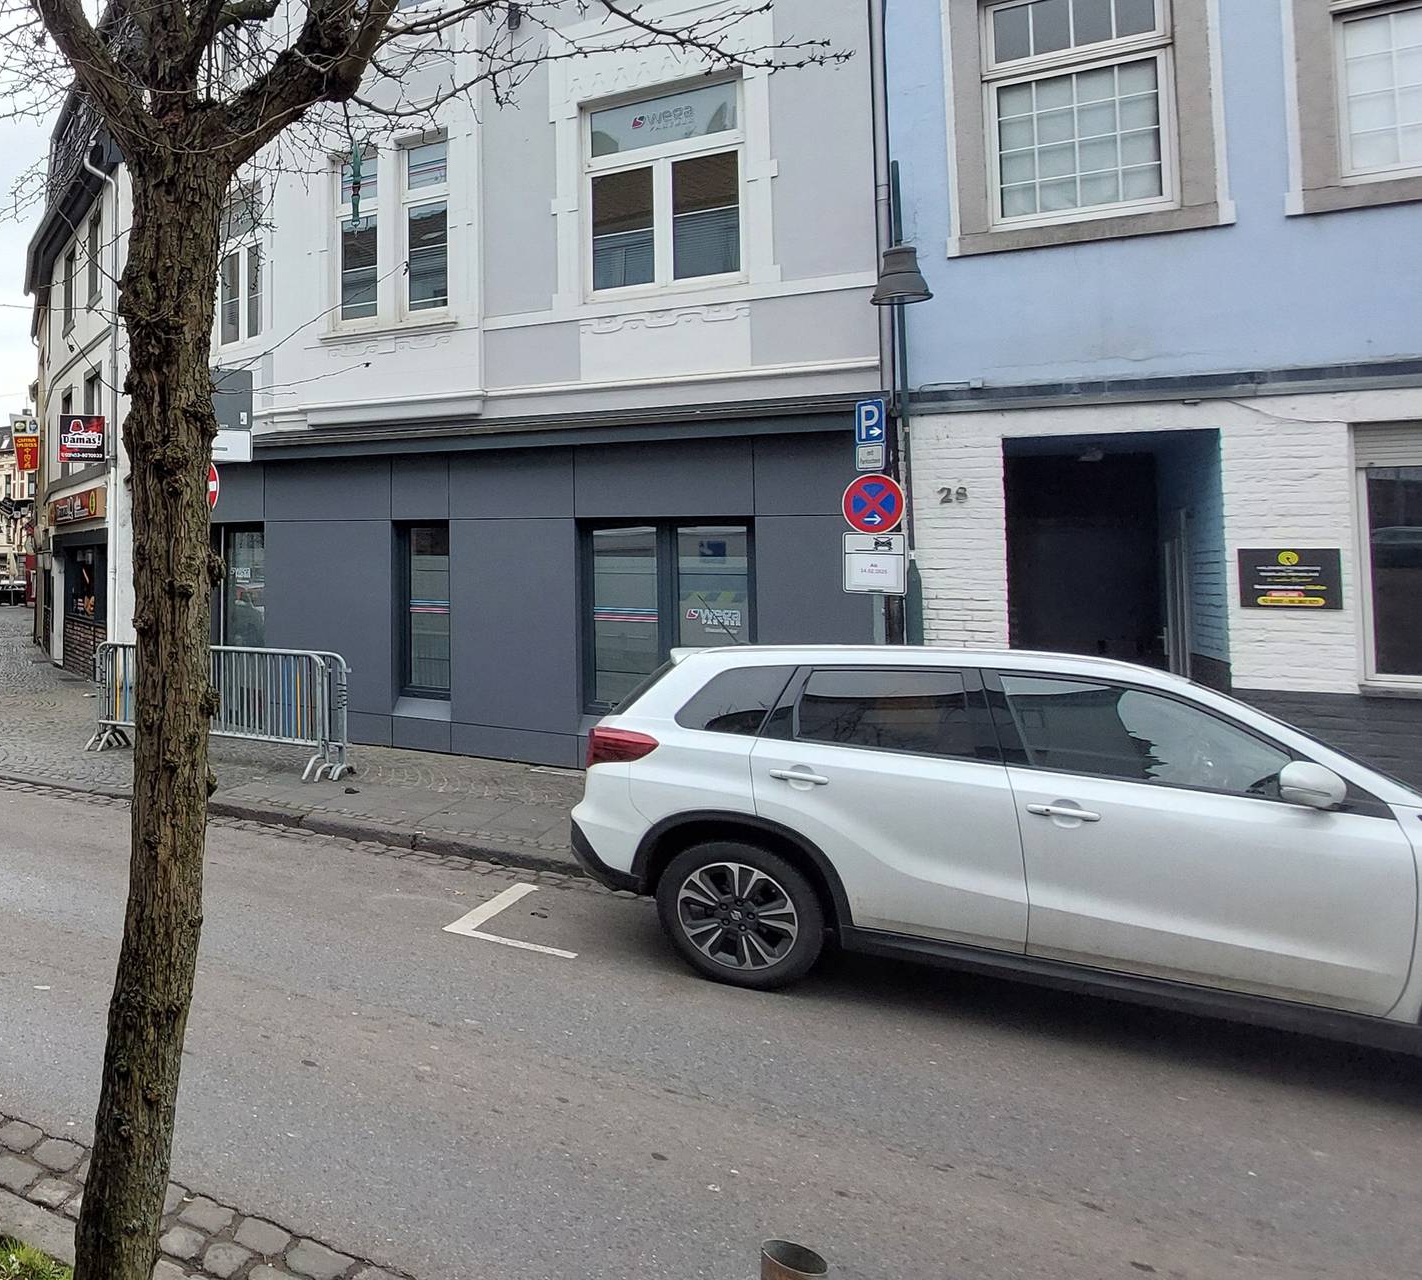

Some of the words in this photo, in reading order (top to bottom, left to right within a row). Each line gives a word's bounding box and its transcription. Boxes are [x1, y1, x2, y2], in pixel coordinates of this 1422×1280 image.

[860, 405, 879, 440] P
[62, 434, 102, 446] Damas!
[938, 486, 968, 505] 28
